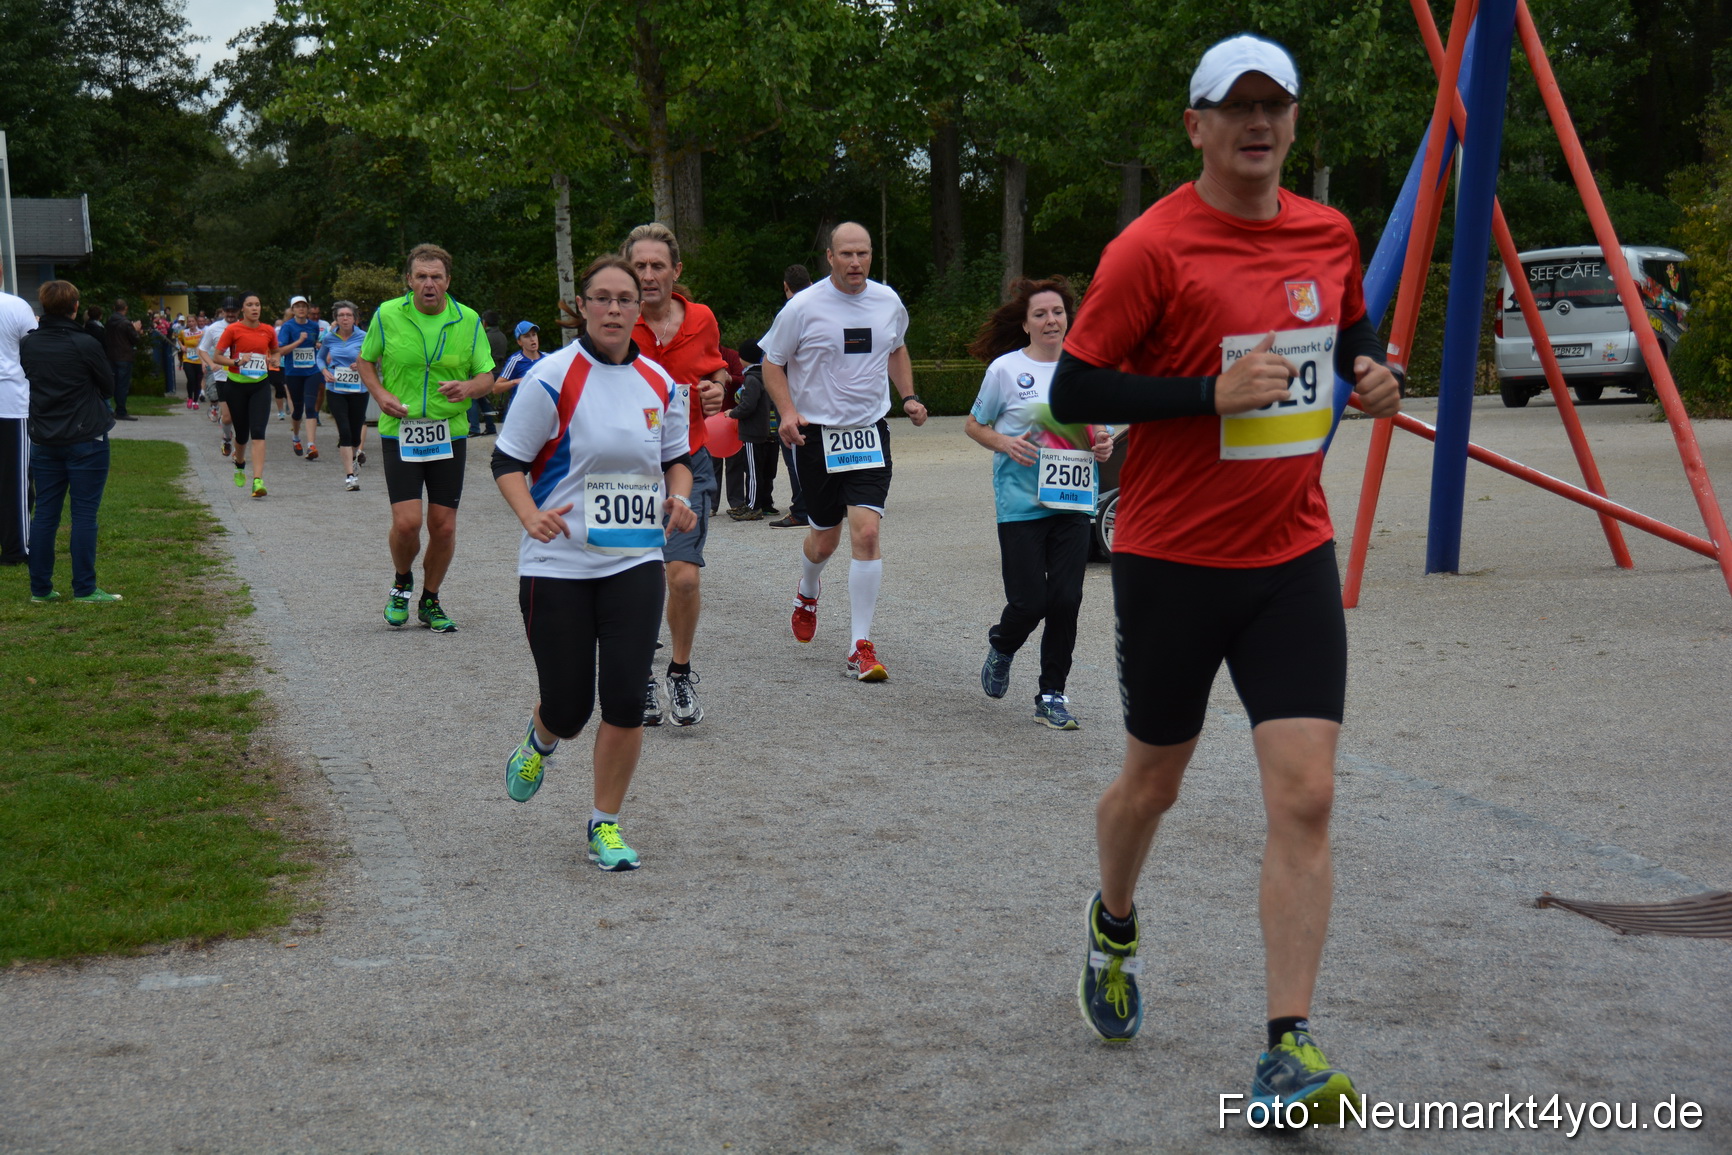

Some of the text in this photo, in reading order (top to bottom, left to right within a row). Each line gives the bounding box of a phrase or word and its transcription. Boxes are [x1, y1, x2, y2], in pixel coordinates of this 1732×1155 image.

[1269, 341, 1321, 356] Neumarkt
[295, 352, 314, 361] 2075
[337, 373, 359, 383] 2229
[404, 424, 446, 444] 2350
[829, 429, 876, 452] 2080
[412, 446, 440, 455] Manfred
[837, 454, 873, 464] Wolfgang
[1041, 453, 1062, 462] PARTL
[1045, 463, 1091, 488] 2503
[586, 482, 651, 491] PARTL Neumarkt
[1059, 491, 1079, 501] Anita
[594, 494, 656, 525] 3094
